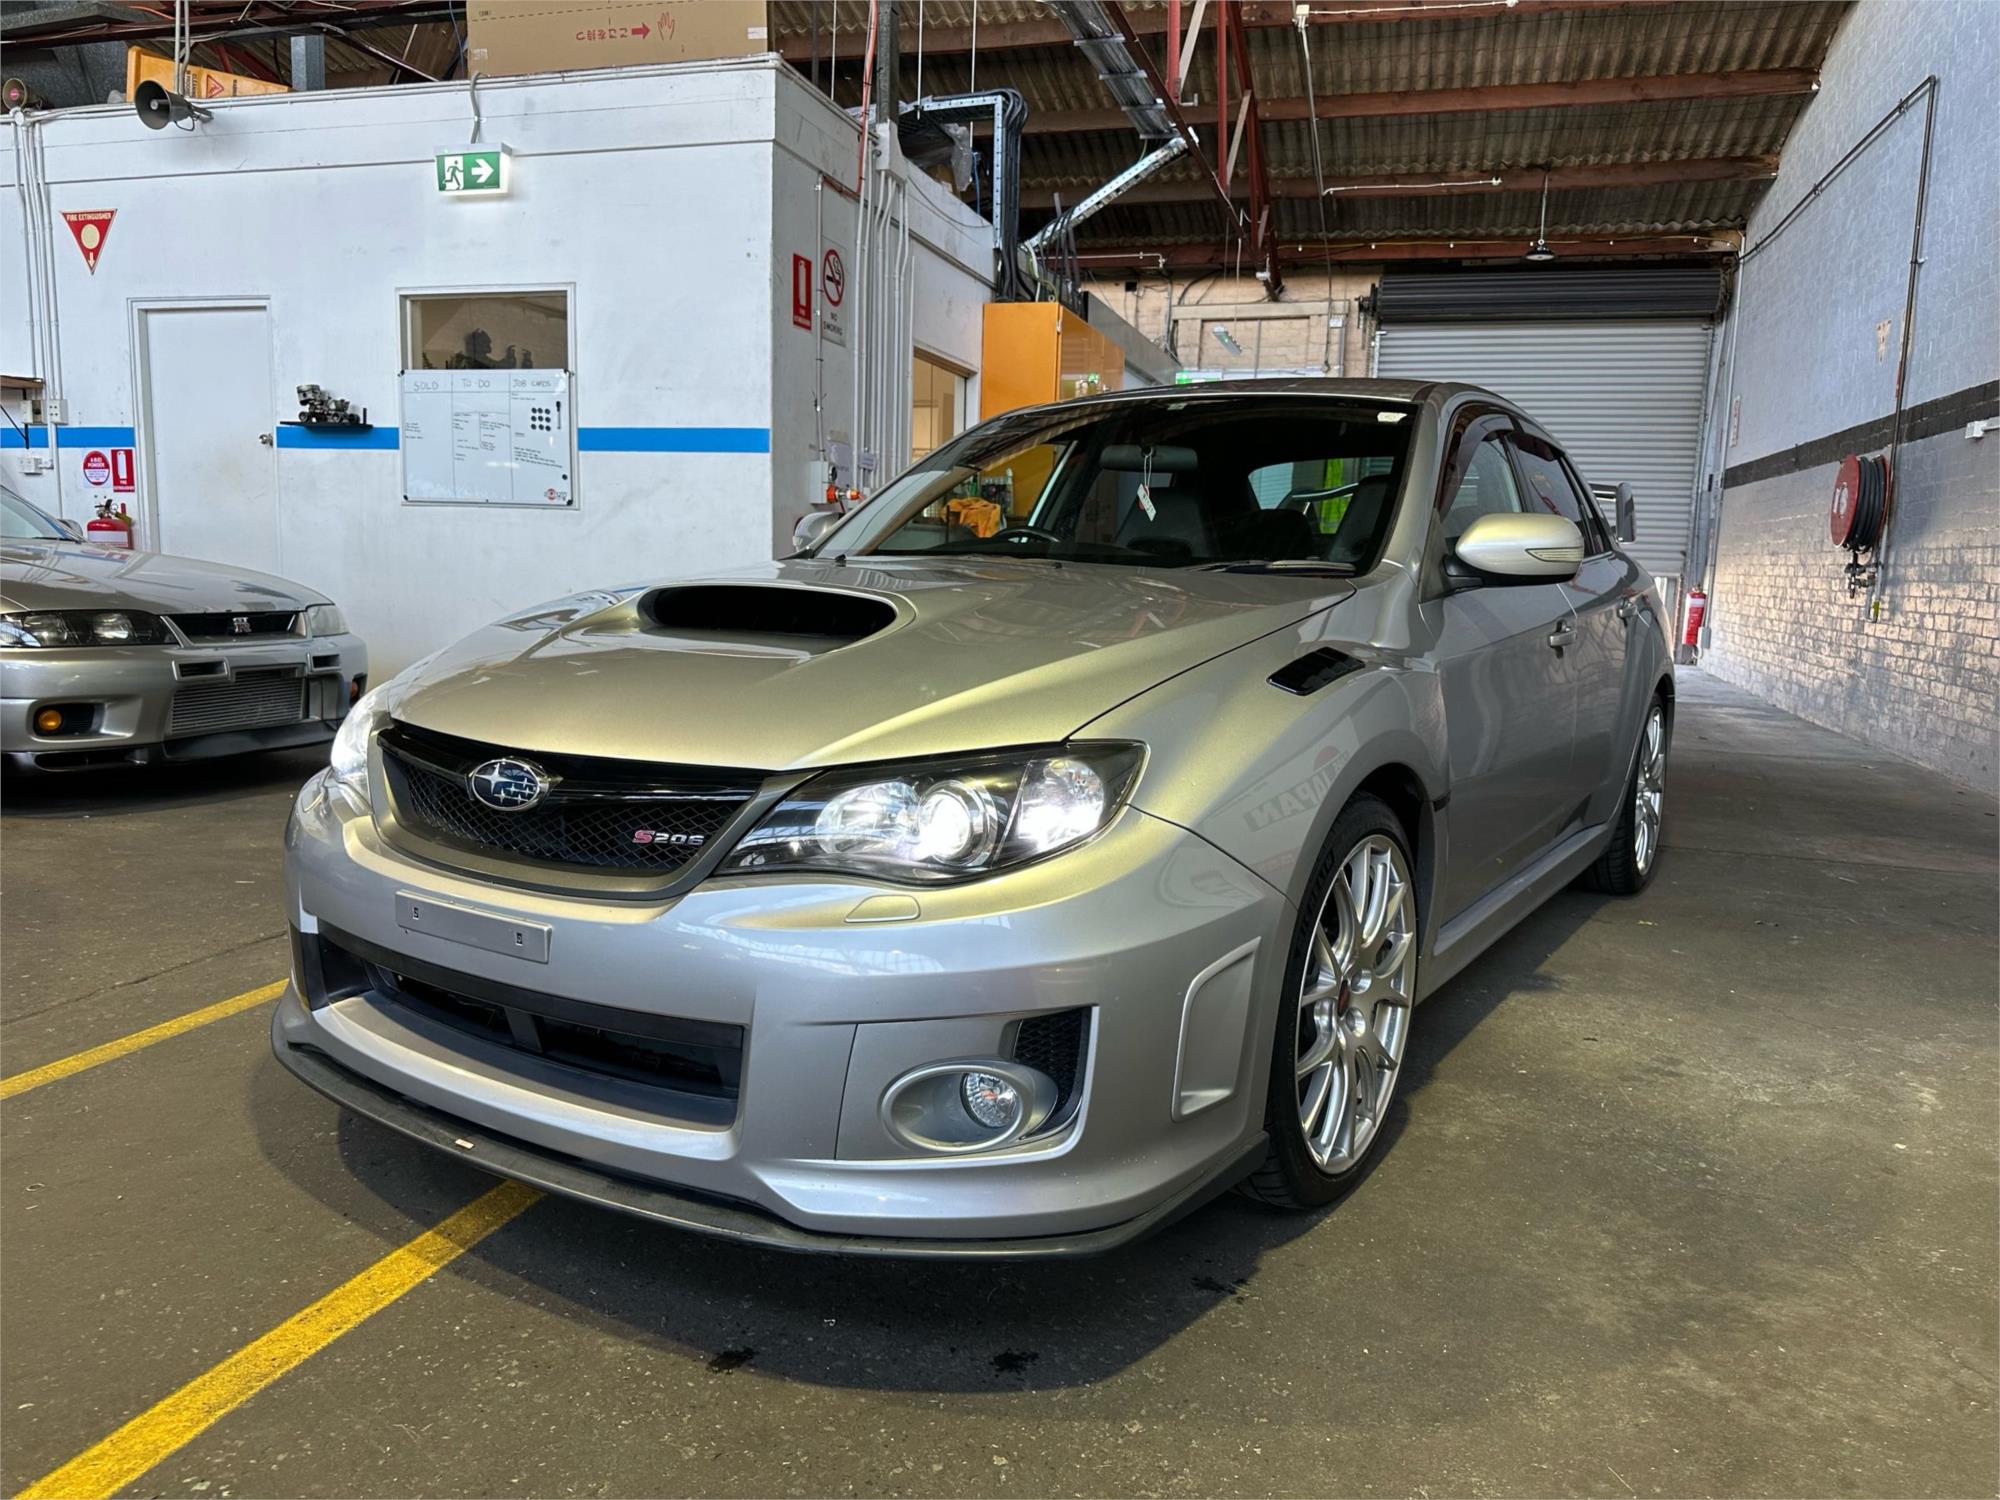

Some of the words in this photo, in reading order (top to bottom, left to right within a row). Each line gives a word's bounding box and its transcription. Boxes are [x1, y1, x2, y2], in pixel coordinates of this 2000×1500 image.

[576, 27, 628, 41] ここを持つ
[414, 381, 438, 391] SOLD
[632, 829, 705, 846] S206
